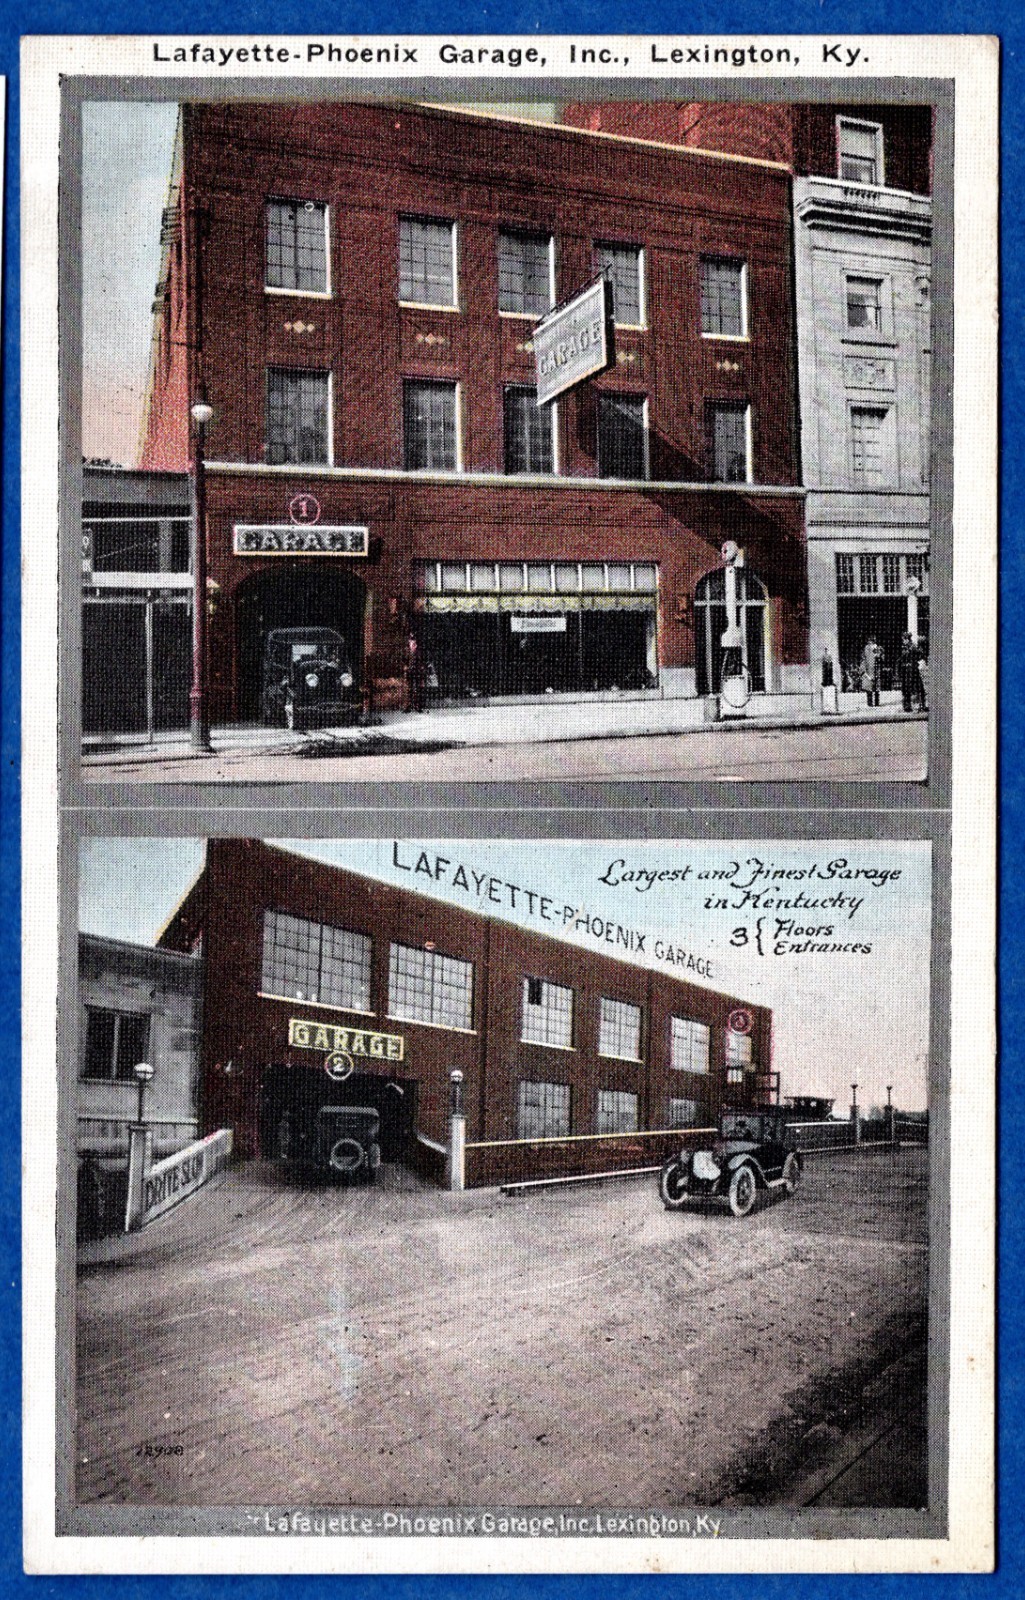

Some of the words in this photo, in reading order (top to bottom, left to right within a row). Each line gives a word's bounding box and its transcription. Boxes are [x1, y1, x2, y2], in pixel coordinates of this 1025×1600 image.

[540, 319, 603, 377] GARAGE
[240, 530, 365, 551] GARAGE
[393, 841, 646, 953] LAFAYETTE-PHOENIX
[655, 940, 714, 979] GARAGE
[294, 1022, 400, 1058] GARAGE
[333, 1056, 345, 1073] 2
